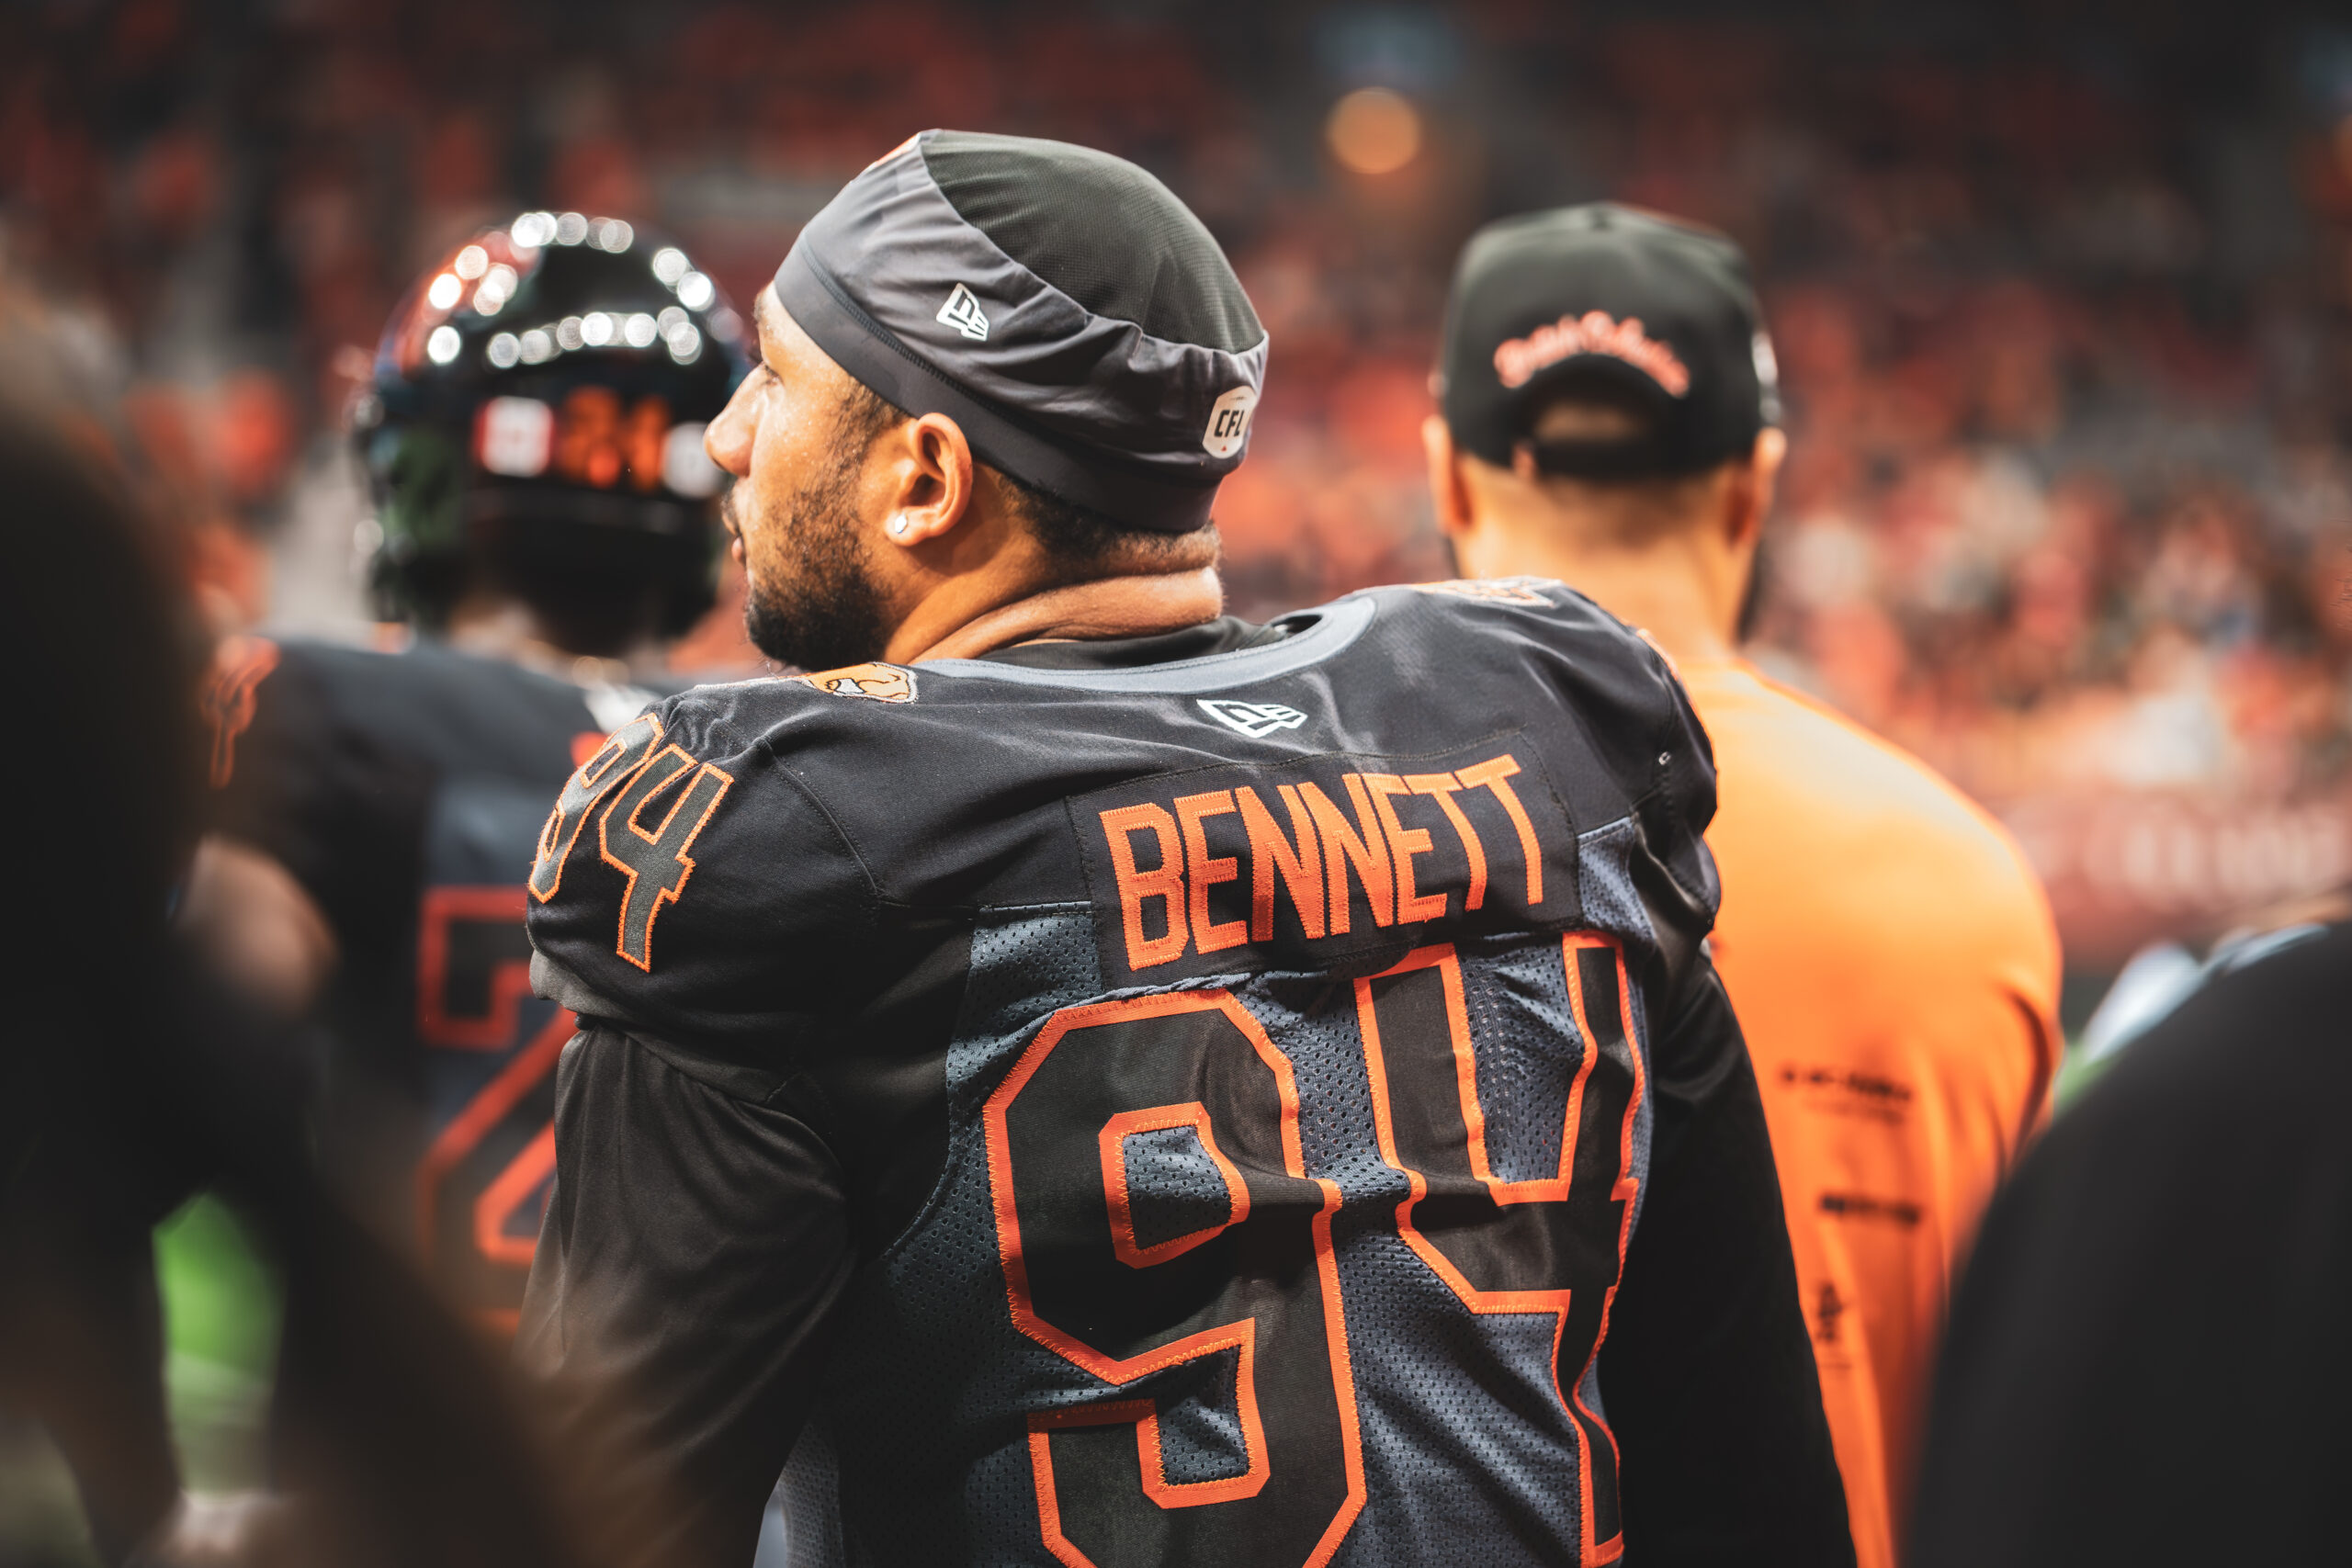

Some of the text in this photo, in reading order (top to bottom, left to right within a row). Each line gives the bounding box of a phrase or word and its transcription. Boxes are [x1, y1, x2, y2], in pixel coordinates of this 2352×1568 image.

[1214, 409, 1245, 438] CFL
[528, 712, 734, 973] 94
[1100, 754, 1544, 971] BENNETT
[983, 931, 1645, 1568] 94
